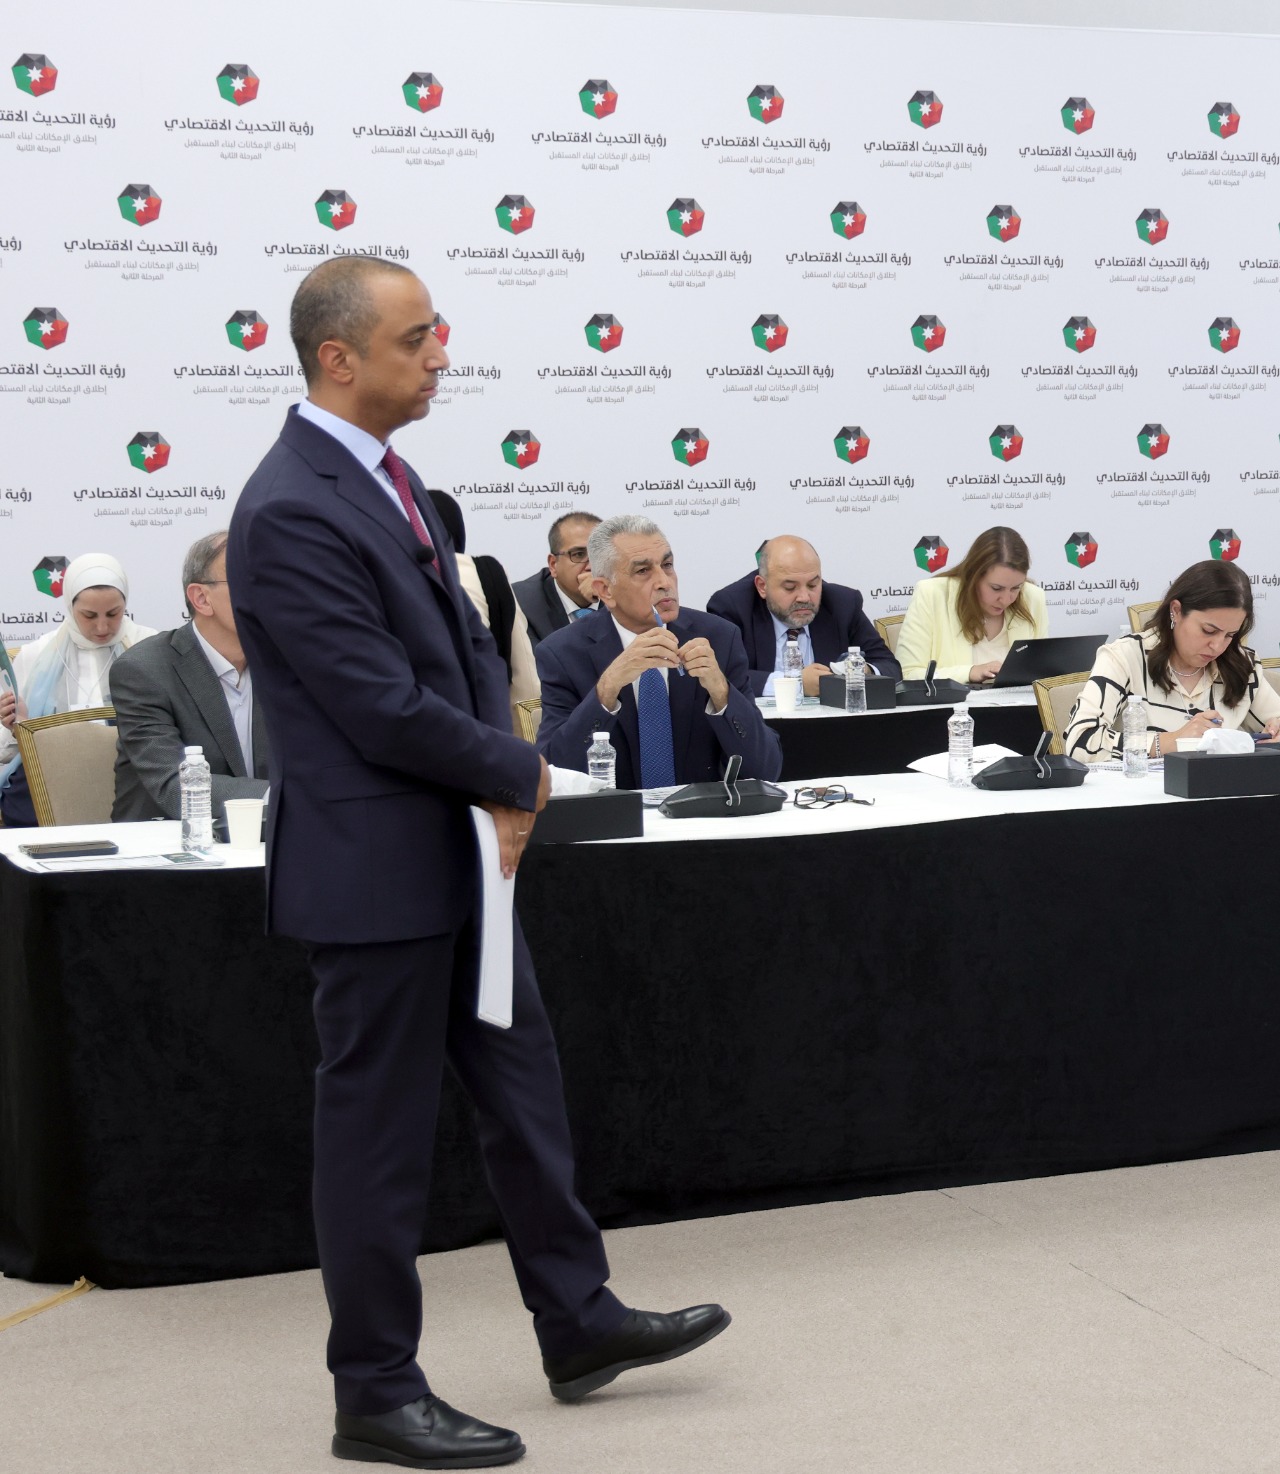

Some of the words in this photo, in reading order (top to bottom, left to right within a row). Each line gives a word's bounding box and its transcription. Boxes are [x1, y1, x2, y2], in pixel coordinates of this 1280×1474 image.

[164, 117, 231, 131] الاقتصادي
[235, 119, 286, 134] التحديث
[289, 121, 314, 136] رؤية
[531, 131, 592, 144] الاقتصادي
[595, 132, 641, 146] التحديث
[644, 133, 667, 147] رؤية
[1018, 145, 1071, 158] الاقتصادي
[1074, 147, 1114, 160] التحديث
[1117, 148, 1137, 161] رؤية
[64, 238, 133, 252] الاقتصادي
[137, 240, 188, 254] التحديث
[192, 241, 217, 256] رؤية
[620, 249, 679, 262] الاقتصادي
[682, 250, 727, 263] التحديث
[730, 251, 752, 264] رؤية
[944, 254, 997, 266] الاقتصادي
[1000, 255, 1041, 267] التحديث
[1043, 255, 1064, 268] رؤية
[537, 365, 597, 379] الاقتصادي
[601, 365, 646, 379] التحديث
[649, 365, 671, 379] رؤية
[1021, 365, 1073, 378] الاقتصادي
[1076, 365, 1116, 378] التحديث
[1118, 365, 1138, 378] رؤية
[789, 476, 845, 490] الاقتصادي
[848, 475, 891, 489] التحديث
[893, 475, 914, 488] رؤية
[74, 486, 141, 502] الاقتصادي
[145, 486, 196, 501] التحديث
[199, 485, 224, 500] رؤية
